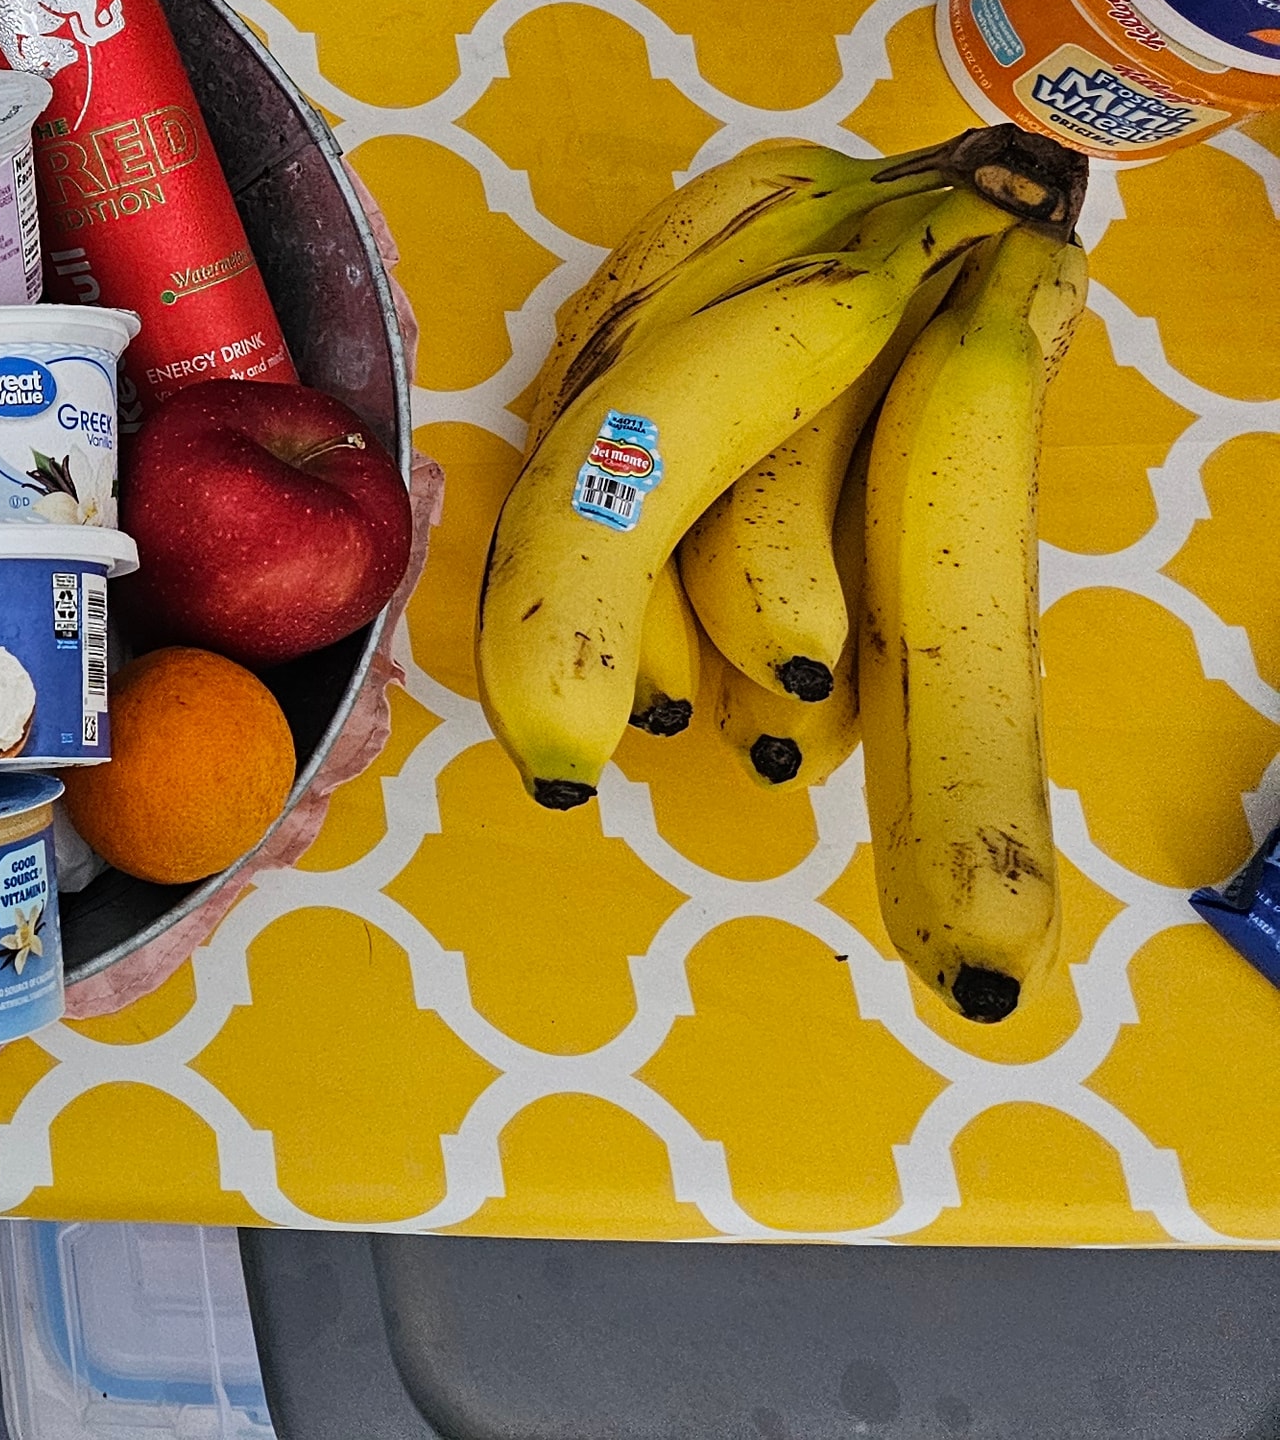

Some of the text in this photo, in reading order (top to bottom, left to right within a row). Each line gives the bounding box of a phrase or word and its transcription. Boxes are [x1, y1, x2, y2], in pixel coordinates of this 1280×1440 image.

[1058, 70, 1195, 132] Mini
[1094, 71, 1189, 117] Frosted
[1037, 79, 1164, 143] Wheats
[1049, 113, 1121, 147] ORIGINAL
[39, 105, 199, 208] RED
[146, 332, 266, 386] ENERGY DRINK
[57, 404, 112, 436] GREEK
[86, 432, 113, 451] Vanilla
[591, 445, 649, 469] Del Monte
[3, 867, 39, 890] SOURCE
[11, 854, 36, 873] GOOD
[0, 885, 40, 908] VITAMIN
